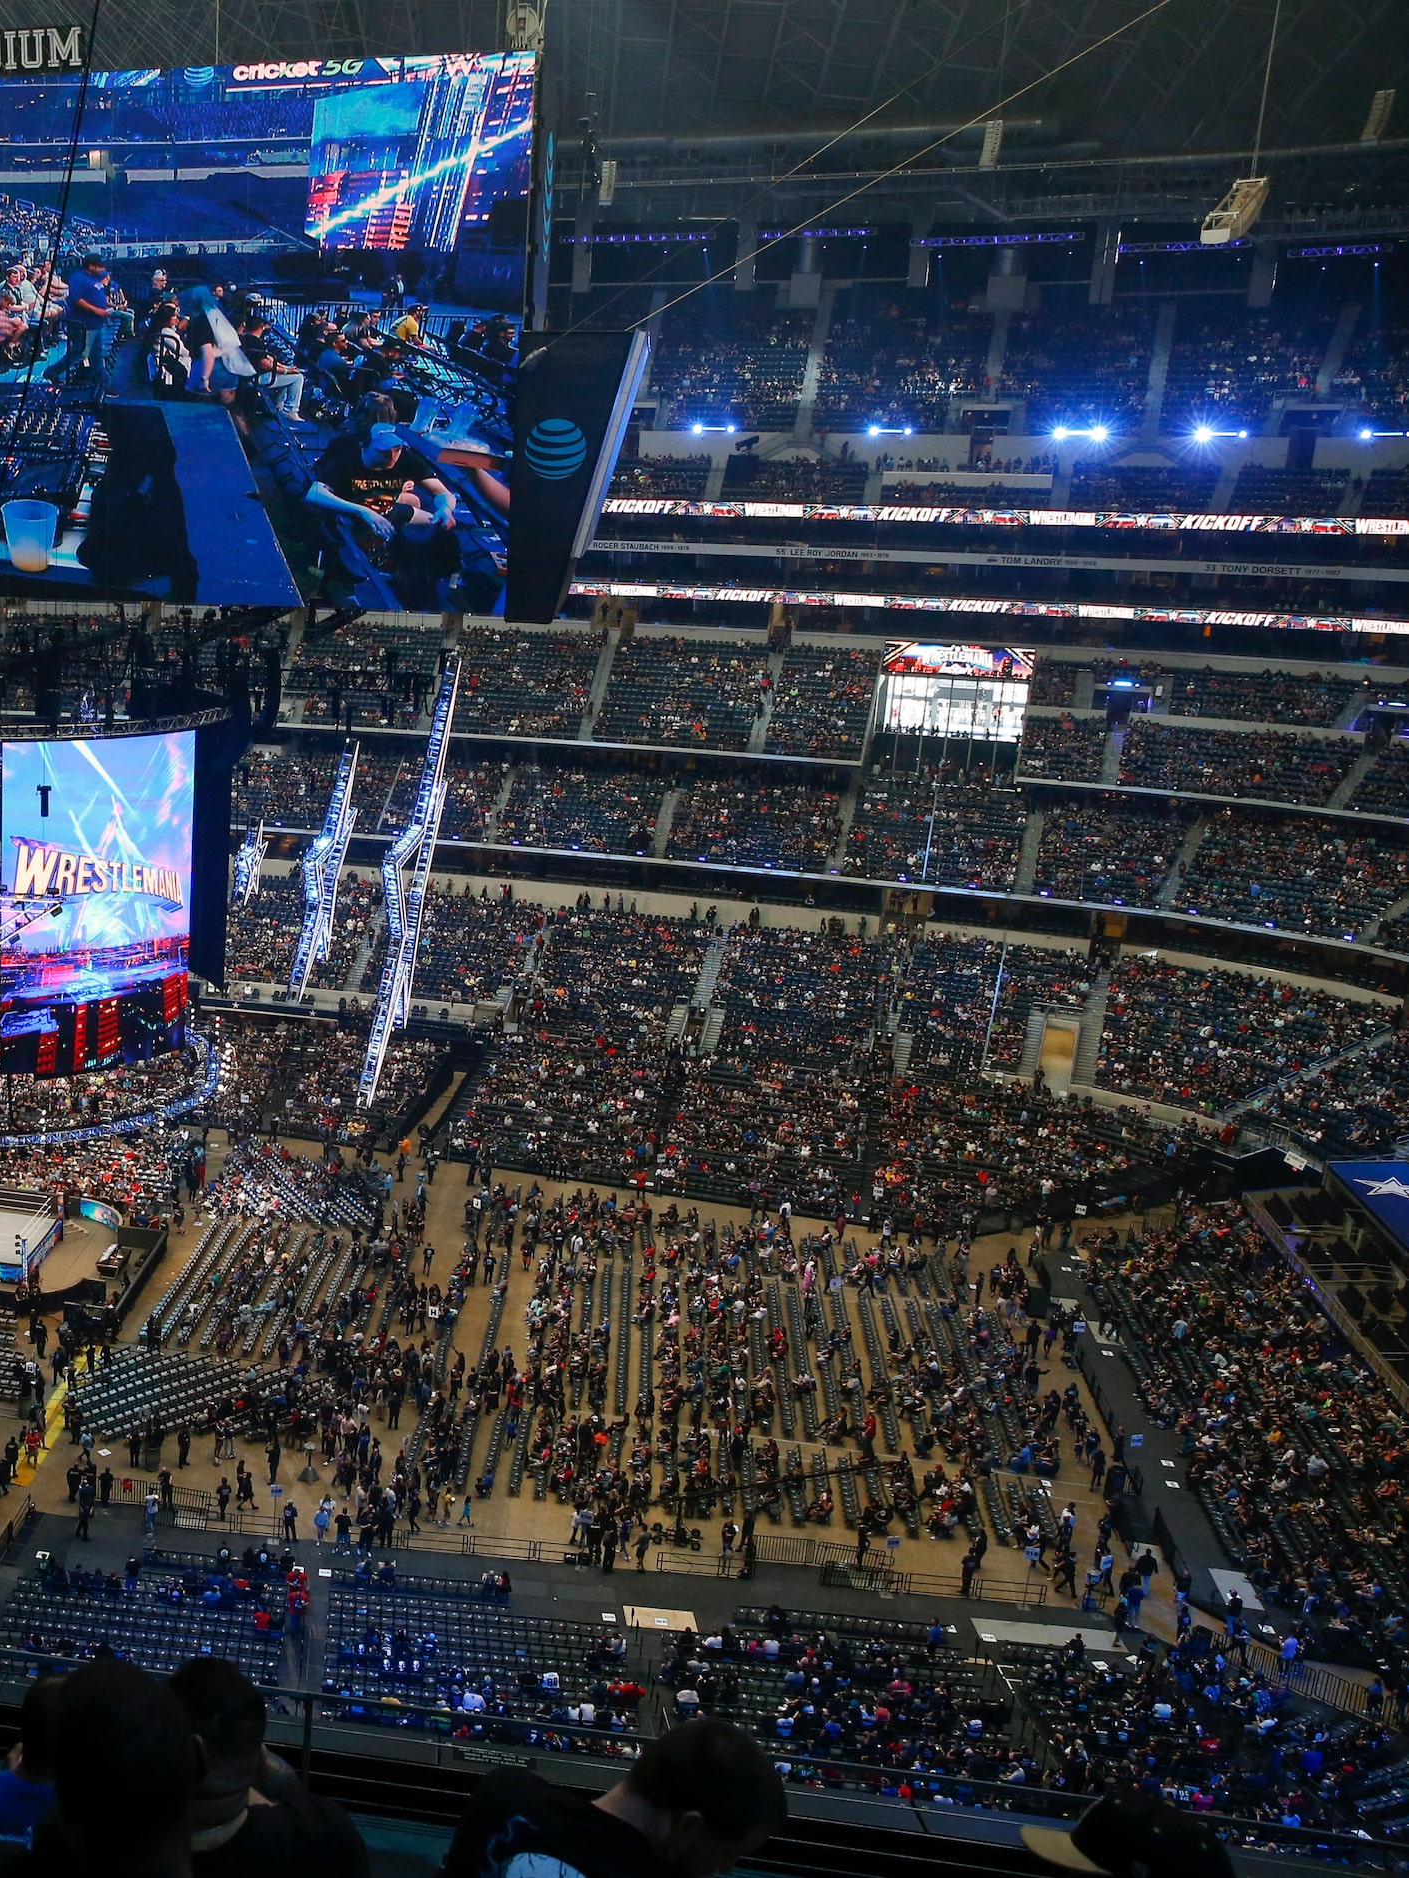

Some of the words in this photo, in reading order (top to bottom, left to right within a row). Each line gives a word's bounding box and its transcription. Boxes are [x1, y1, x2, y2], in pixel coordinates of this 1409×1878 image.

[232, 60, 322, 81] cricket
[321, 58, 364, 77] 5G
[608, 499, 674, 514] KICKOFF
[877, 506, 951, 522] KICKOFF
[1179, 514, 1264, 531] KICKOFF
[592, 541, 618, 550] ROGER
[620, 542, 659, 551] STAUBACH
[790, 548, 805, 556] LEE
[807, 549, 823, 557] ROY
[825, 550, 858, 558] JORDAN
[1001, 556, 1021, 564] TOM
[1024, 557, 1062, 566] LANDRY
[1204, 564, 1216, 572] 33
[1221, 565, 1248, 573] TONY
[1252, 566, 1301, 575] DORSETT
[715, 589, 773, 602] KICKOFF
[948, 599, 1011, 614] KICKOFF
[1204, 611, 1276, 627] KICKOFF
[15, 845, 183, 905] WRESTLEMANIA
